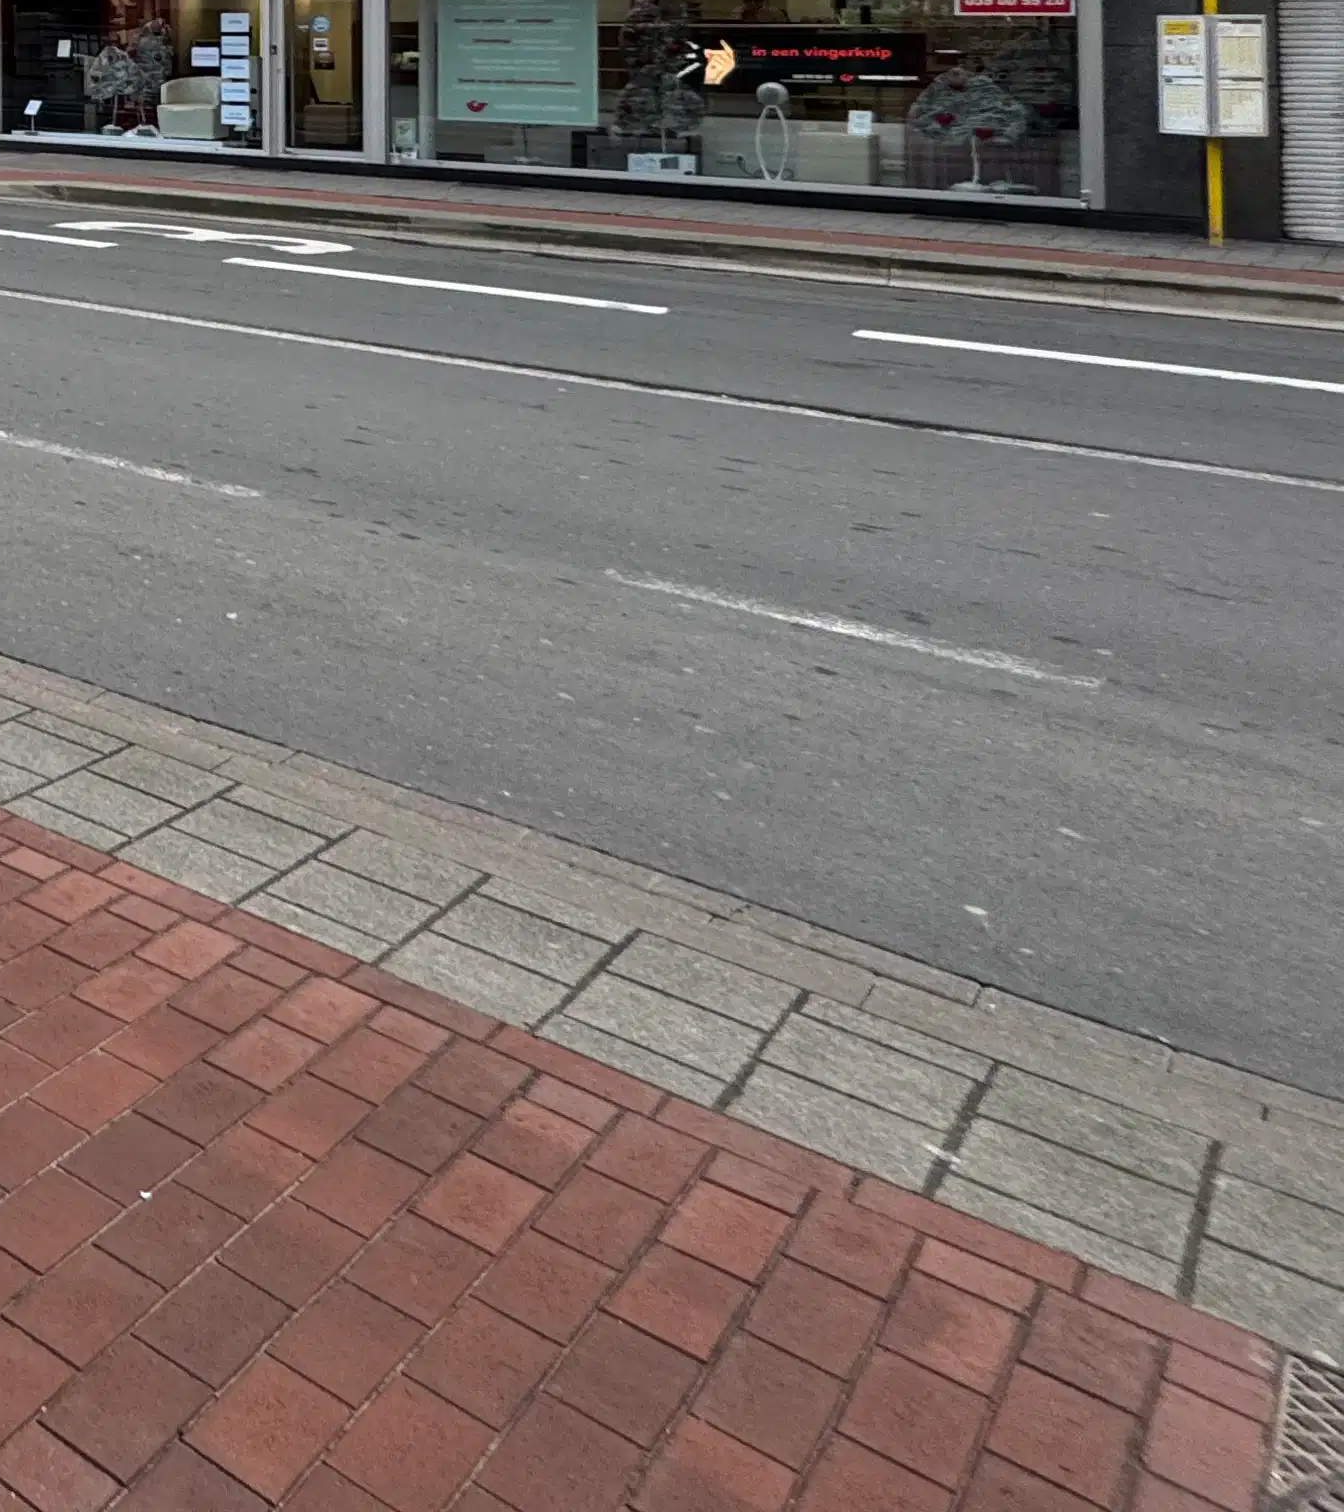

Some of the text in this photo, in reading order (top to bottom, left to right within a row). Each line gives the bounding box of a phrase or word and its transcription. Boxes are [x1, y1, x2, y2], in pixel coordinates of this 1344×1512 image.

[751, 45, 893, 60] in een vingerknip
